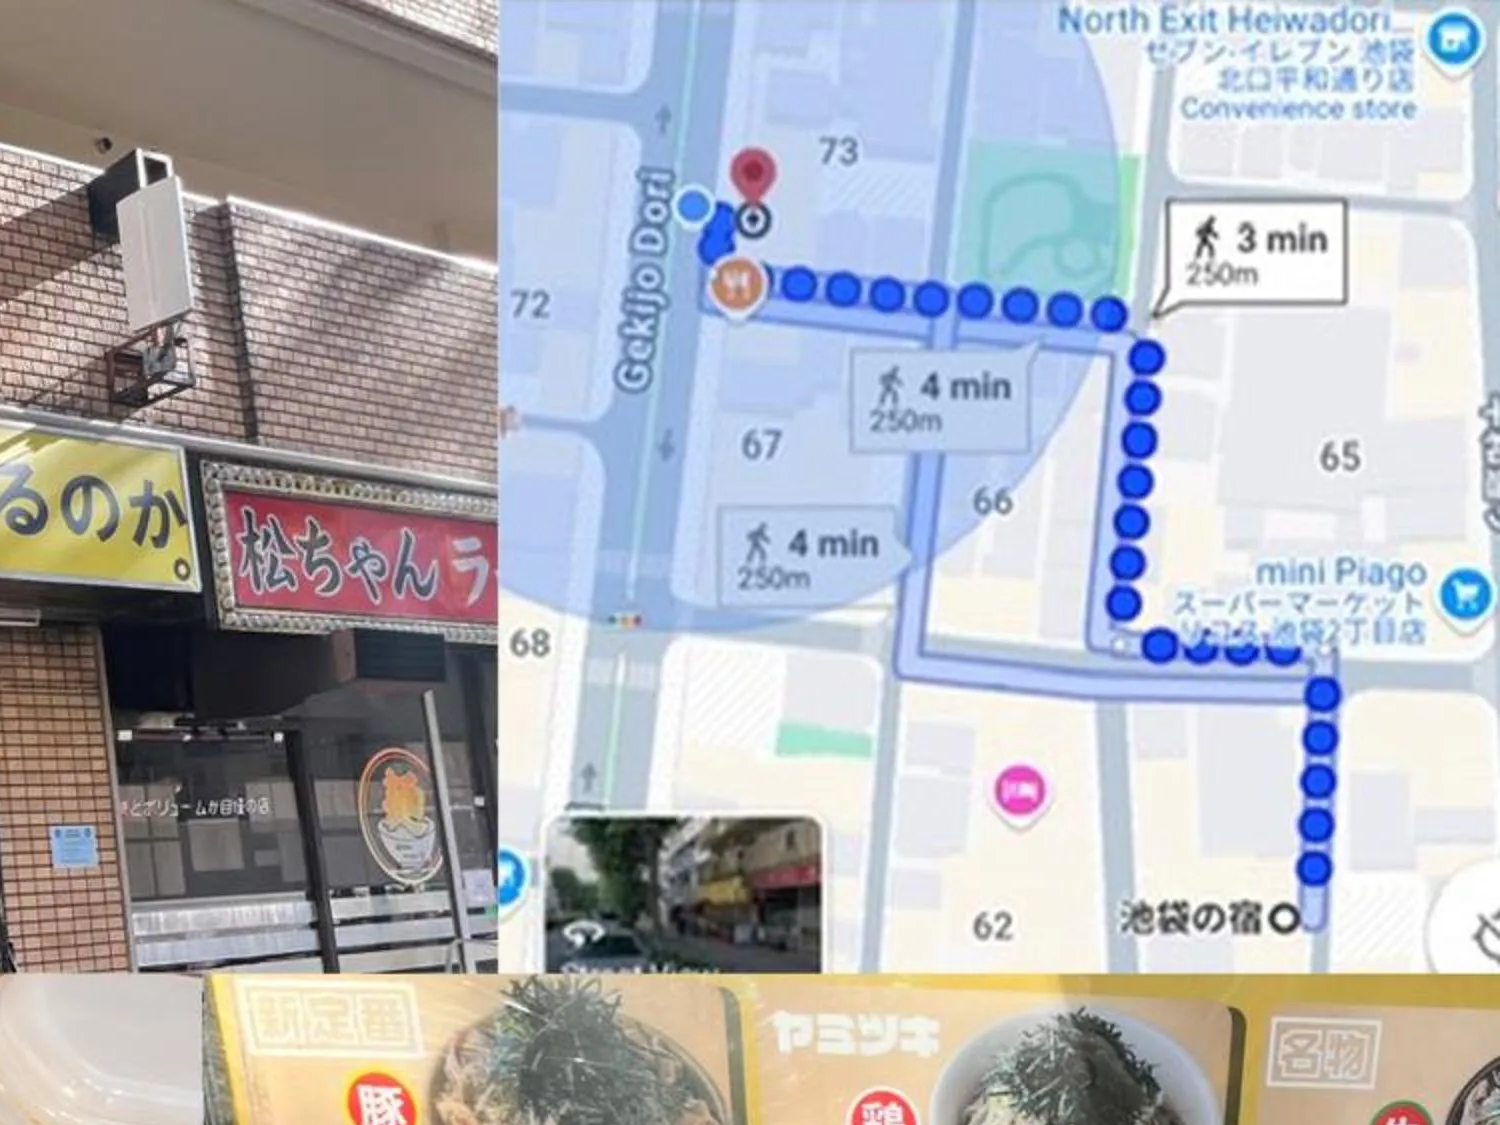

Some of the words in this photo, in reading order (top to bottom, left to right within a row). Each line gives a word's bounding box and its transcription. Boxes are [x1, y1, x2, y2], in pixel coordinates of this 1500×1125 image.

[1058, 7, 1149, 33] North
[1160, 7, 1218, 33] Exit
[1181, 97, 1343, 119] Convenience
[1352, 98, 1417, 119] store
[819, 138, 859, 166] 73
[1237, 225, 1258, 253] 3
[1267, 224, 1328, 253] min
[1187, 264, 1259, 287] 250m
[510, 290, 551, 319] 72
[920, 372, 939, 399] 4
[950, 371, 1012, 400] min
[870, 410, 942, 434] 250m
[743, 430, 782, 459] 67
[1320, 441, 1362, 472] 65
[974, 488, 1013, 515] 66
[237, 504, 500, 607] 松ちゃんラ
[789, 531, 808, 558] 4
[819, 530, 879, 558] min
[738, 568, 811, 591] 250m
[1257, 558, 1325, 585] mini
[1336, 557, 1427, 592] Piago
[1174, 591, 1423, 615] スーパーマーケット
[510, 629, 551, 657] 68
[972, 911, 1014, 941] 62
[1120, 900, 1263, 937] 池袋の宿
[772, 1010, 940, 1059] ヤミツキ
[1278, 1028, 1374, 1080] 名物
